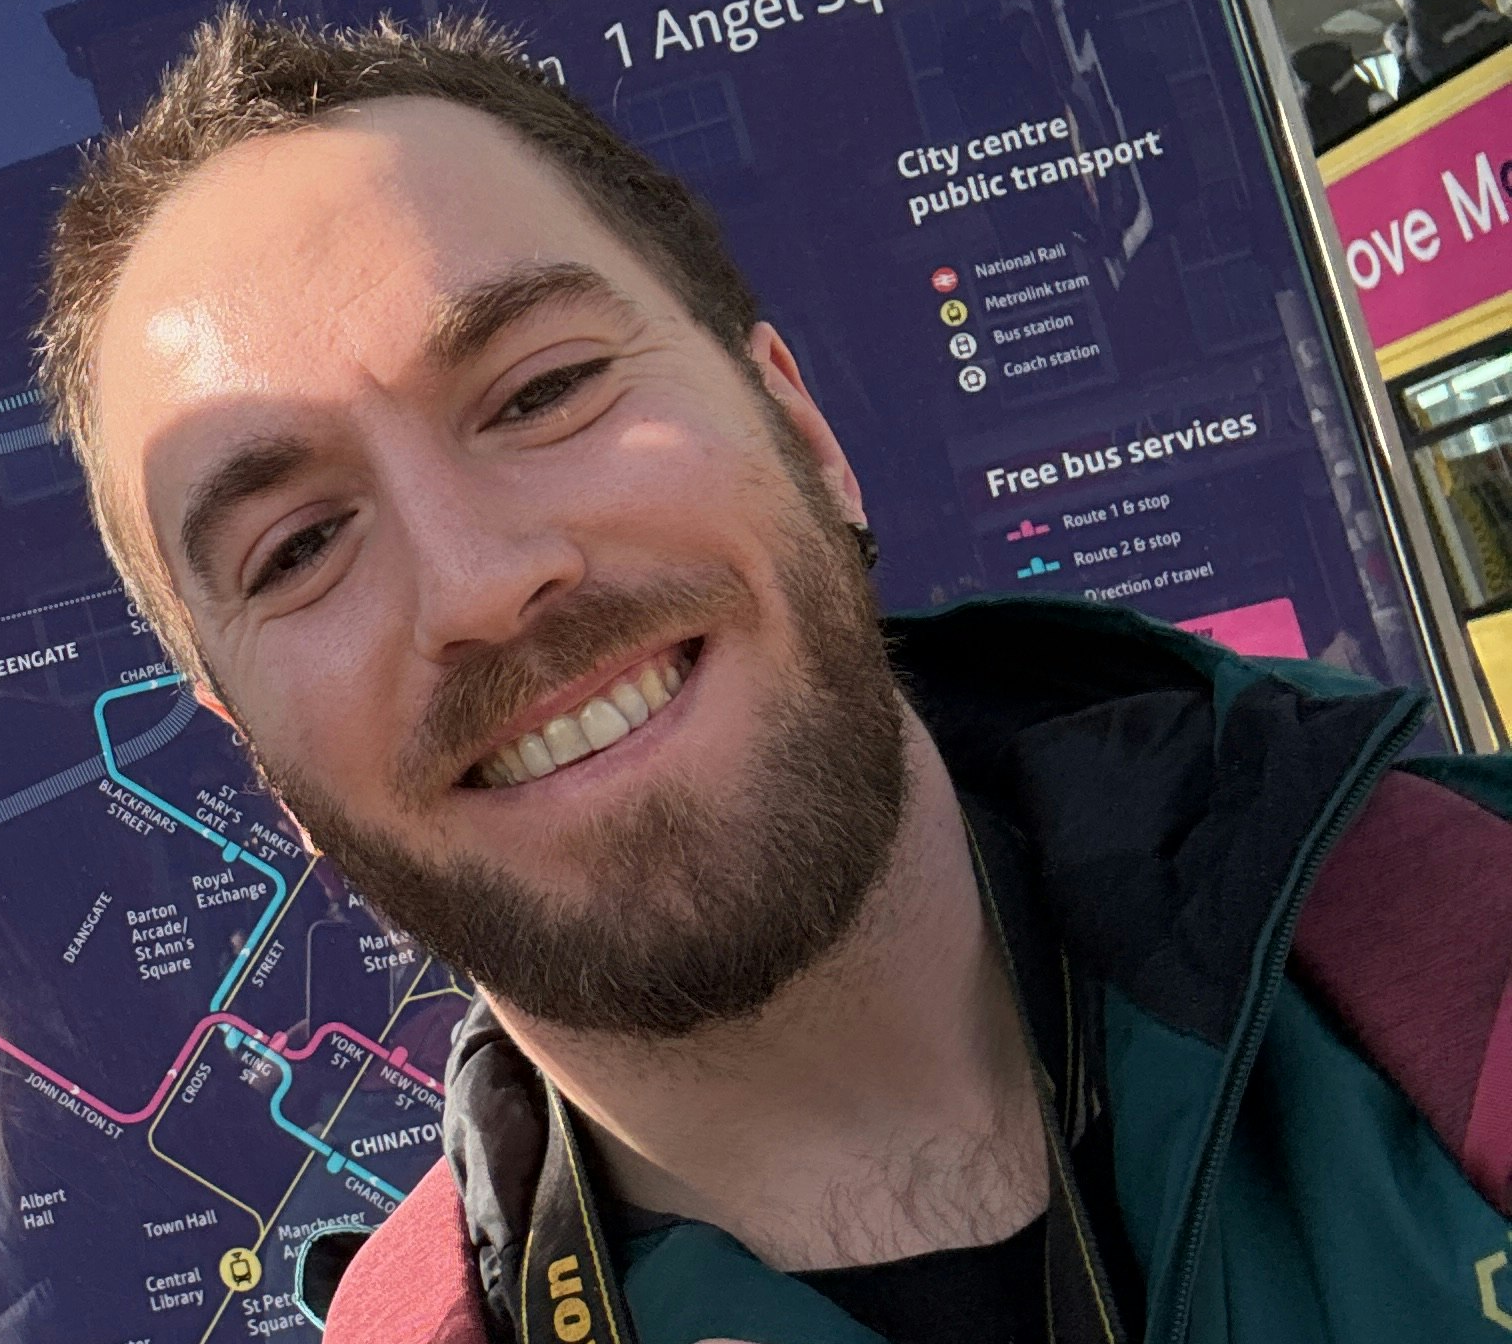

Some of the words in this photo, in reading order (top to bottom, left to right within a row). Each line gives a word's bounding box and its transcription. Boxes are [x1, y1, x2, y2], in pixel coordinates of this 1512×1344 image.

[604, 22, 634, 69] 1
[897, 144, 959, 179] City
[967, 117, 1070, 160] centre
[908, 170, 1007, 225] public
[1010, 131, 1163, 190] transport
[975, 250, 1035, 279] National
[1037, 243, 1067, 263] Rail
[985, 283, 1054, 312] Metrolink
[1054, 275, 1089, 293] tram
[993, 326, 1021, 345] Bus
[1023, 313, 1074, 338] station
[1003, 356, 1048, 378] Coach
[1049, 342, 1100, 367] station
[987, 463, 1058, 497] Free
[1062, 445, 1122, 478] bus
[1127, 411, 1258, 463] services
[1063, 508, 1107, 529] Route
[1109, 505, 1119, 519] 1
[1123, 502, 1135, 515] &
[1137, 493, 1170, 515] stop
[1073, 544, 1118, 567] Route
[1120, 541, 1131, 556] 2
[1134, 537, 1147, 552] &
[1148, 530, 1181, 552] stop
[1154, 570, 1169, 587] of
[1172, 561, 1214, 583] travel
[120, 662, 171, 684] CHAPEL
[218, 784, 238, 801] ST
[99, 779, 179, 834] BLACKFRIARS
[107, 802, 155, 836] STREET
[195, 807, 229, 833] GATE
[196, 790, 244, 824] MARY'S
[250, 822, 303, 860] MARKET
[259, 845, 278, 861] ST
[192, 868, 234, 892] Royal
[196, 882, 268, 909] Exchange
[63, 890, 114, 964] DEANSGATE
[126, 903, 178, 926] Barton
[132, 917, 188, 944] Arcade/
[135, 946, 152, 962] St
[154, 937, 195, 958] Ann's
[363, 948, 416, 973] Street
[139, 958, 192, 981] Square
[251, 939, 286, 989] STREET
[330, 1033, 365, 1063] YORK
[331, 1053, 350, 1070] ST
[239, 1068, 259, 1085] ST
[240, 1051, 272, 1077] KING
[181, 1062, 212, 1104] CROSS
[380, 1066, 411, 1090] NEW
[25, 1072, 59, 1100] JOHN
[57, 1092, 106, 1130] DALTON
[105, 1122, 124, 1140] ST
[395, 1094, 415, 1111] ST
[20, 1188, 67, 1211] Albert
[23, 1210, 54, 1230] Hall
[144, 1219, 185, 1238] Town
[186, 1209, 218, 1229] Hall
[278, 1211, 365, 1241] Manchester
[146, 1267, 202, 1293] Central
[149, 1289, 204, 1312] Library
[242, 1298, 261, 1316] St
[247, 1312, 305, 1337] Square
